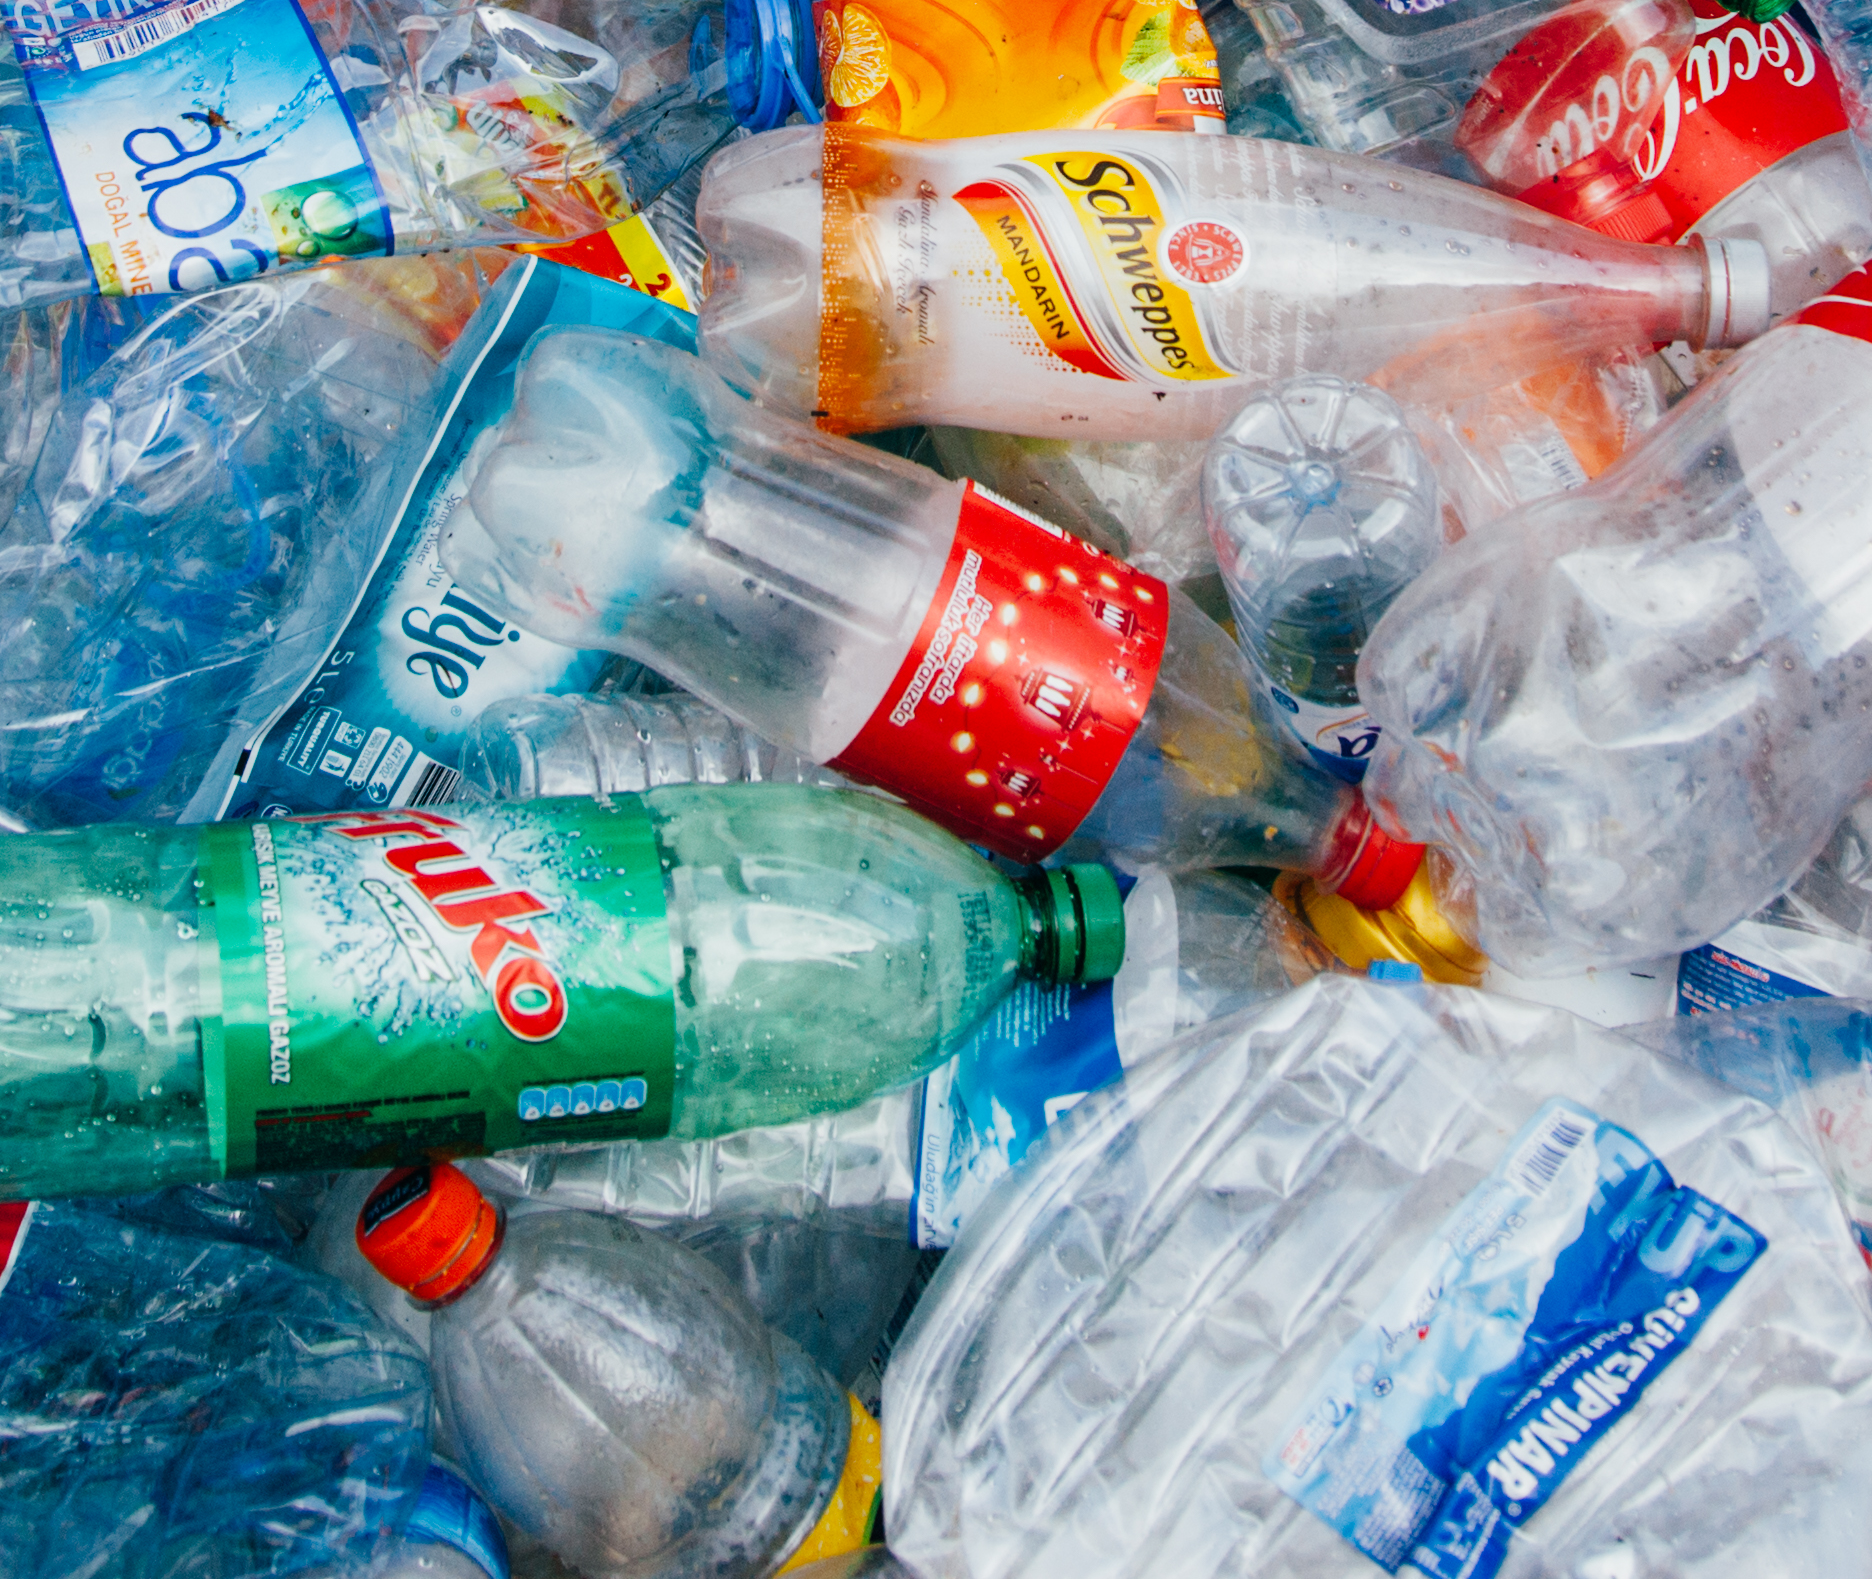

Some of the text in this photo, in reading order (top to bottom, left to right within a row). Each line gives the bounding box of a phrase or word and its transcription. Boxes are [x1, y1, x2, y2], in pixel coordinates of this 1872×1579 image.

[95, 172, 130, 239] DOĞAL
[122, 111, 270, 293] aba
[995, 214, 1072, 341] MANDARIN
[1052, 149, 1197, 377] Schweppes
[360, 878, 459, 983] GAZOZ
[268, 1023, 291, 1085] GAZOZ
